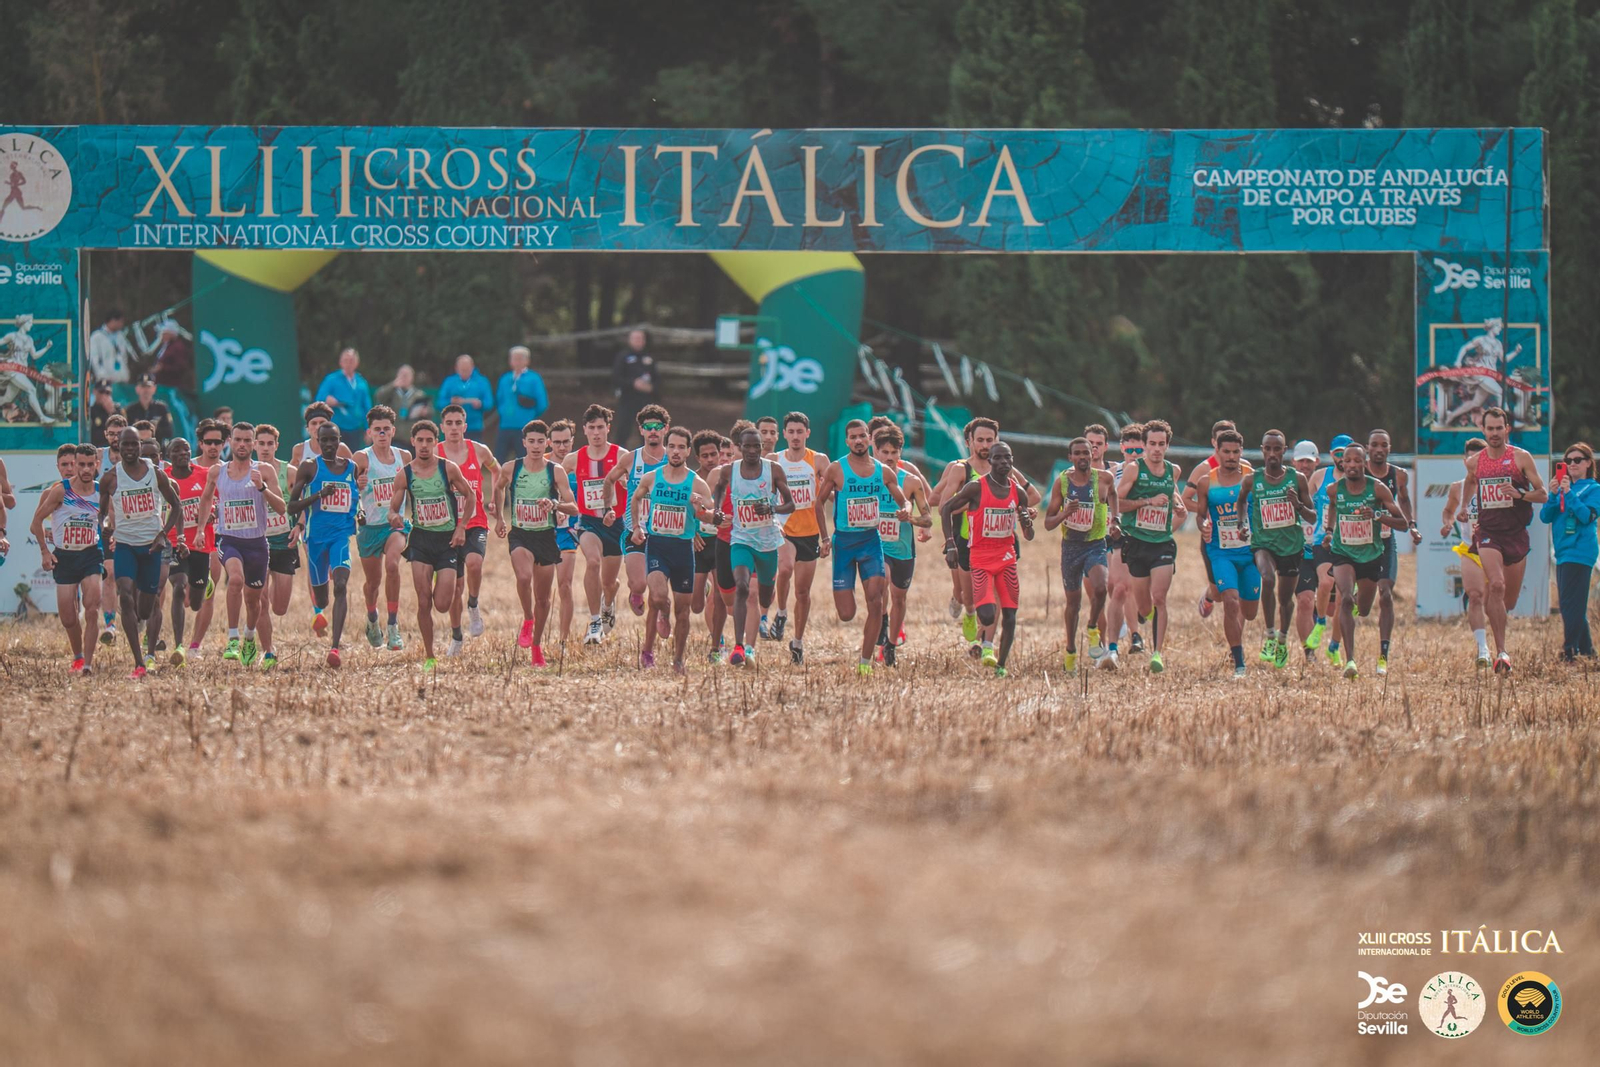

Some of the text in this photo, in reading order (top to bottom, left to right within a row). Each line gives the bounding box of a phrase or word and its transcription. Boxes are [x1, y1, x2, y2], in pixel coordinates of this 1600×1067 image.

[363, 147, 538, 191] CROSS
[618, 128, 1045, 229] ITÁLICA
[1193, 165, 1509, 187] CAMPEONATO DE ANDALUCÍA
[133, 145, 359, 218] XLIII
[1242, 183, 1462, 206] DE CAMPO A TRAVÉS
[364, 195, 602, 219] INTERNACIONAL
[1292, 207, 1417, 226] POR CLUBES
[133, 223, 559, 247] INTERNATIONAL CROSS COUNTRY
[15, 271, 63, 285] Sevilla
[655, 489, 688, 501] nerja
[849, 482, 880, 494] nerja
[235, 505, 256, 523] PINTO
[1137, 507, 1167, 525] MARTIN
[1261, 501, 1294, 523] KWIZERA
